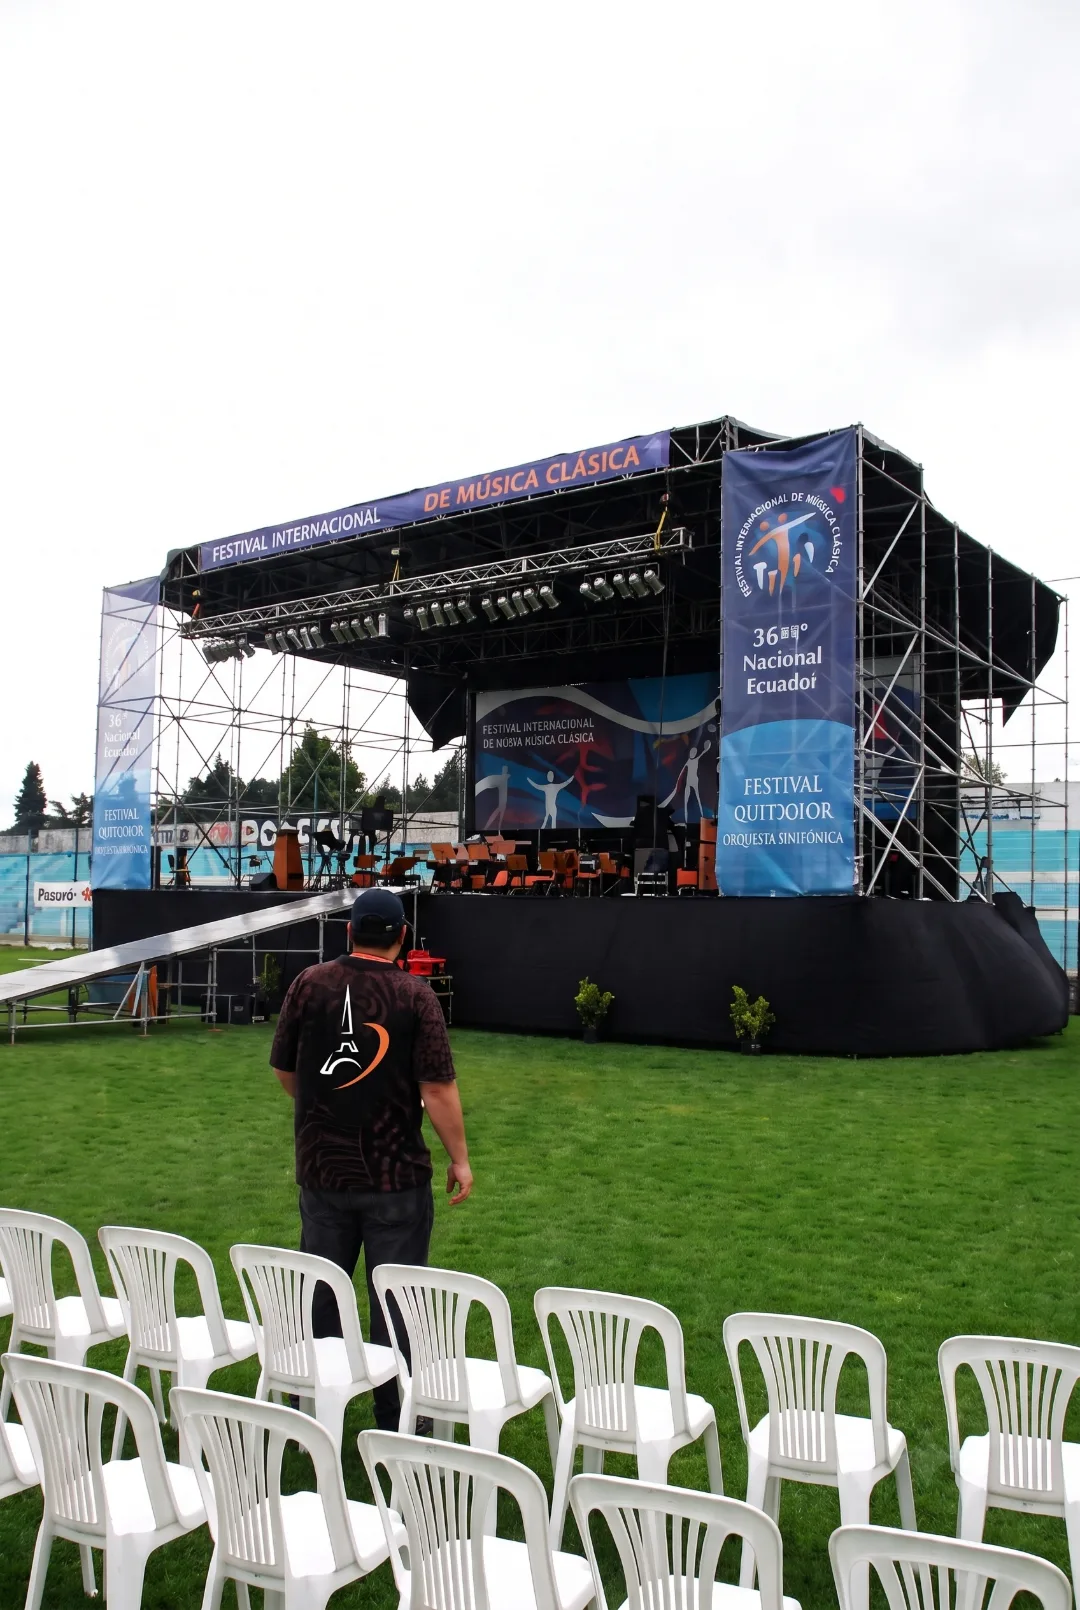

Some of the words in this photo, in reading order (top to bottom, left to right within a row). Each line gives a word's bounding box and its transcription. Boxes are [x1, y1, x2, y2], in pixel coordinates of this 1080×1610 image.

[212, 535, 268, 563] FESTIVAL
[272, 506, 381, 549] INTERNACIONAL
[423, 488, 451, 513] DE
[455, 474, 539, 504] MÚSICA
[545, 445, 640, 484] CLÁSICA
[791, 492, 804, 502] DE
[743, 645, 822, 672] Nacional
[482, 724, 522, 735] FESTIVAL
[523, 717, 595, 732] INTERNACIONAL
[483, 738, 495, 749] DE
[557, 731, 595, 744] CLÁSICA
[743, 774, 823, 796] FESTIVAL
[104, 807, 140, 821] FESTIVAL
[722, 832, 777, 849] ORQUESTA
